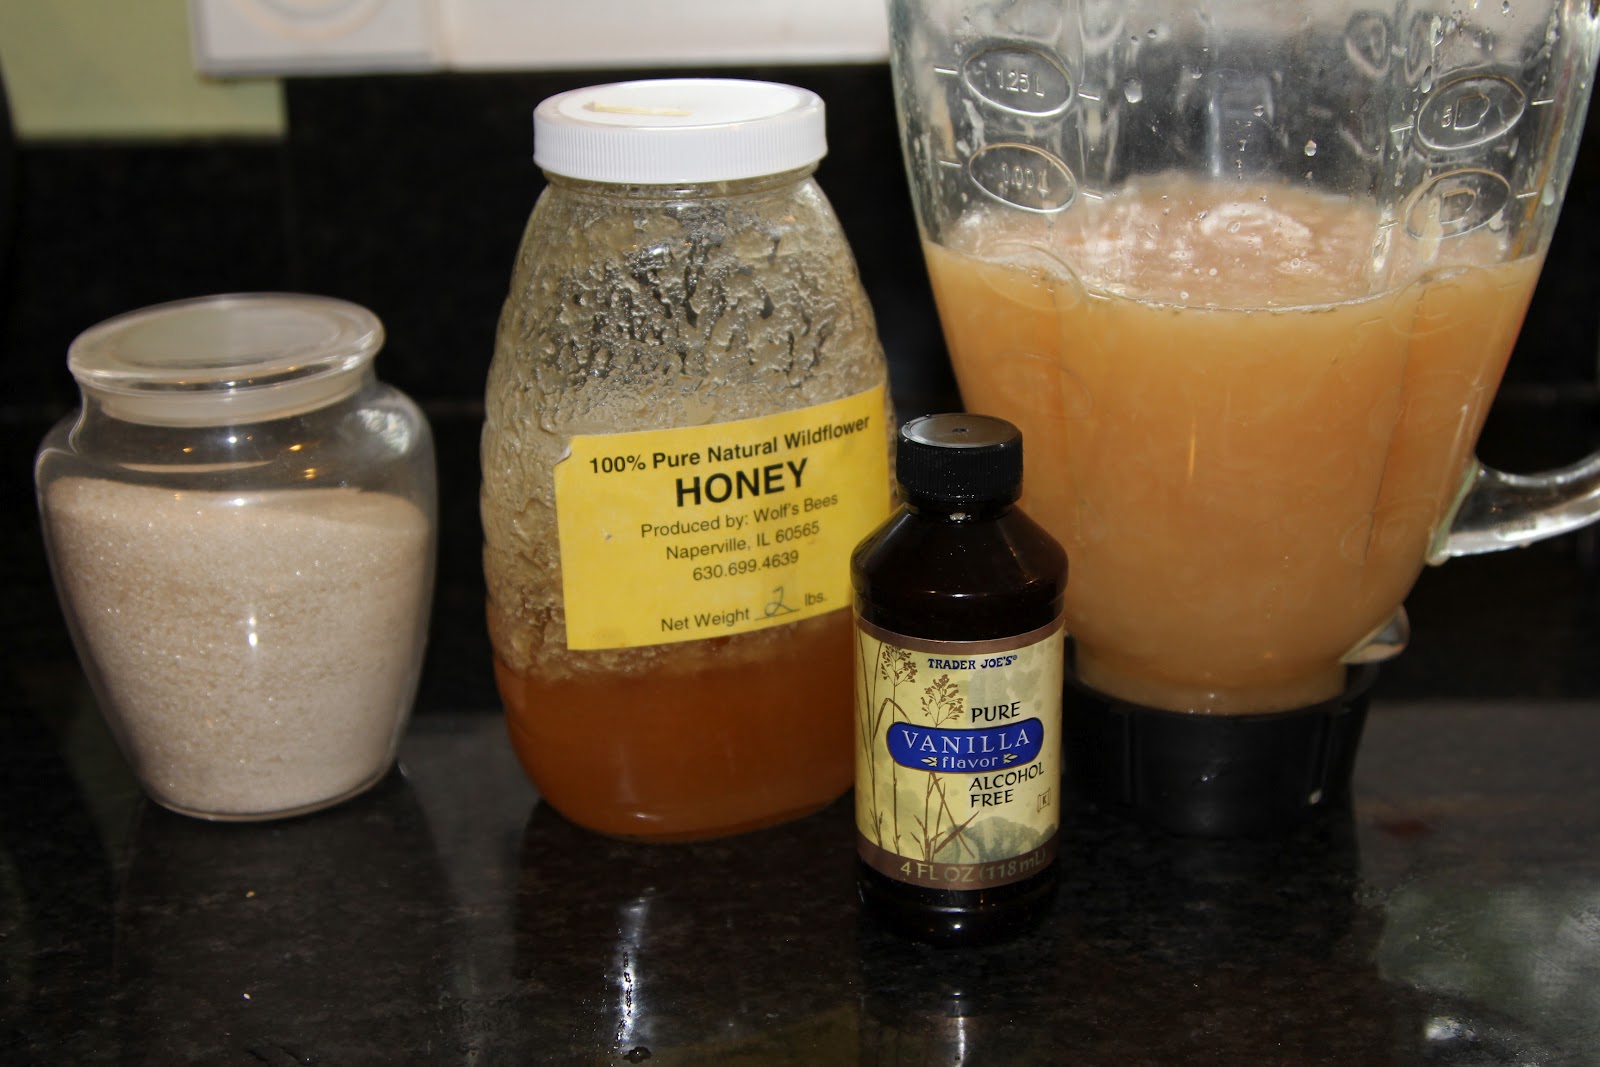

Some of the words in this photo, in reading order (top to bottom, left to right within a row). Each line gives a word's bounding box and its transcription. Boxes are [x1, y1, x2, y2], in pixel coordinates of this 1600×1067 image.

[589, 453, 647, 474] 100%
[652, 448, 701, 469] Pure
[707, 436, 778, 463] Natural
[783, 415, 870, 450] Wildflower
[675, 457, 808, 508] HONEY
[640, 515, 720, 538] Produced
[725, 511, 749, 534] by:
[752, 502, 800, 524] Wolf's
[803, 492, 839, 513] Bees
[665, 536, 751, 562] Naperville,
[756, 531, 771, 548] IL
[775, 520, 820, 544] 60565
[692, 549, 799, 582] 630.699.4639
[660, 616, 689, 632] Net
[694, 607, 750, 631] Weight
[763, 585, 793, 618] 2
[804, 591, 827, 607] lbs.
[928, 658, 976, 670] TRADER
[971, 701, 1022, 724] PURE
[901, 728, 1031, 754] VANILLA
[941, 755, 999, 769] flavor
[968, 761, 1045, 792] ALCOHOL
[970, 788, 1015, 809] FREE
[900, 862, 912, 877] 4
[916, 862, 940, 881] FL
[944, 866, 976, 883] OZ
